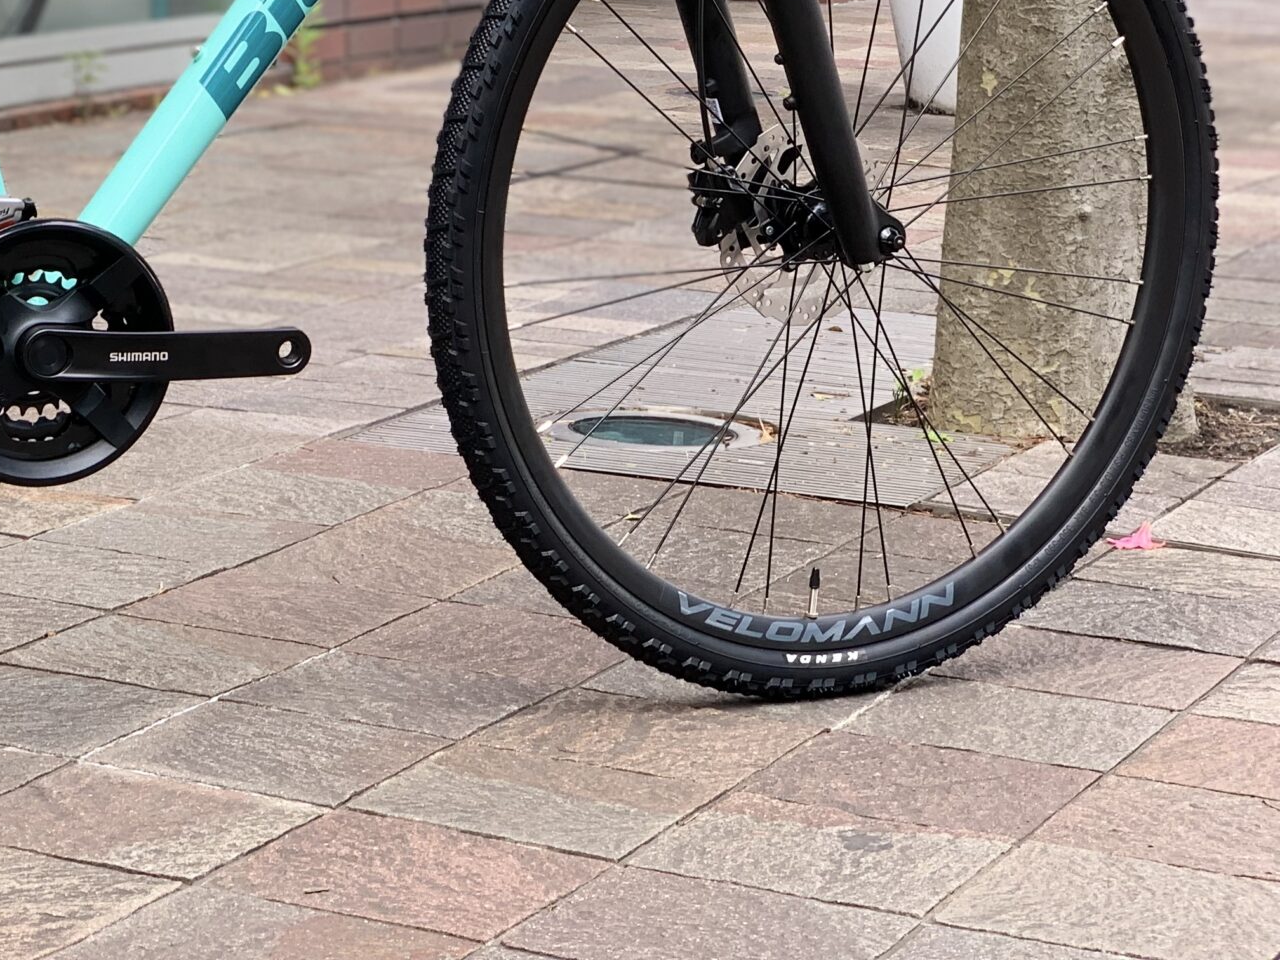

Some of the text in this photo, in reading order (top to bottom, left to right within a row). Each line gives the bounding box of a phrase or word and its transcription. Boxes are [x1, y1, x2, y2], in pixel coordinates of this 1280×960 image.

[109, 350, 169, 363] SHIMANO
[677, 581, 955, 644] VELOMANN
[785, 651, 859, 665] KENDA
